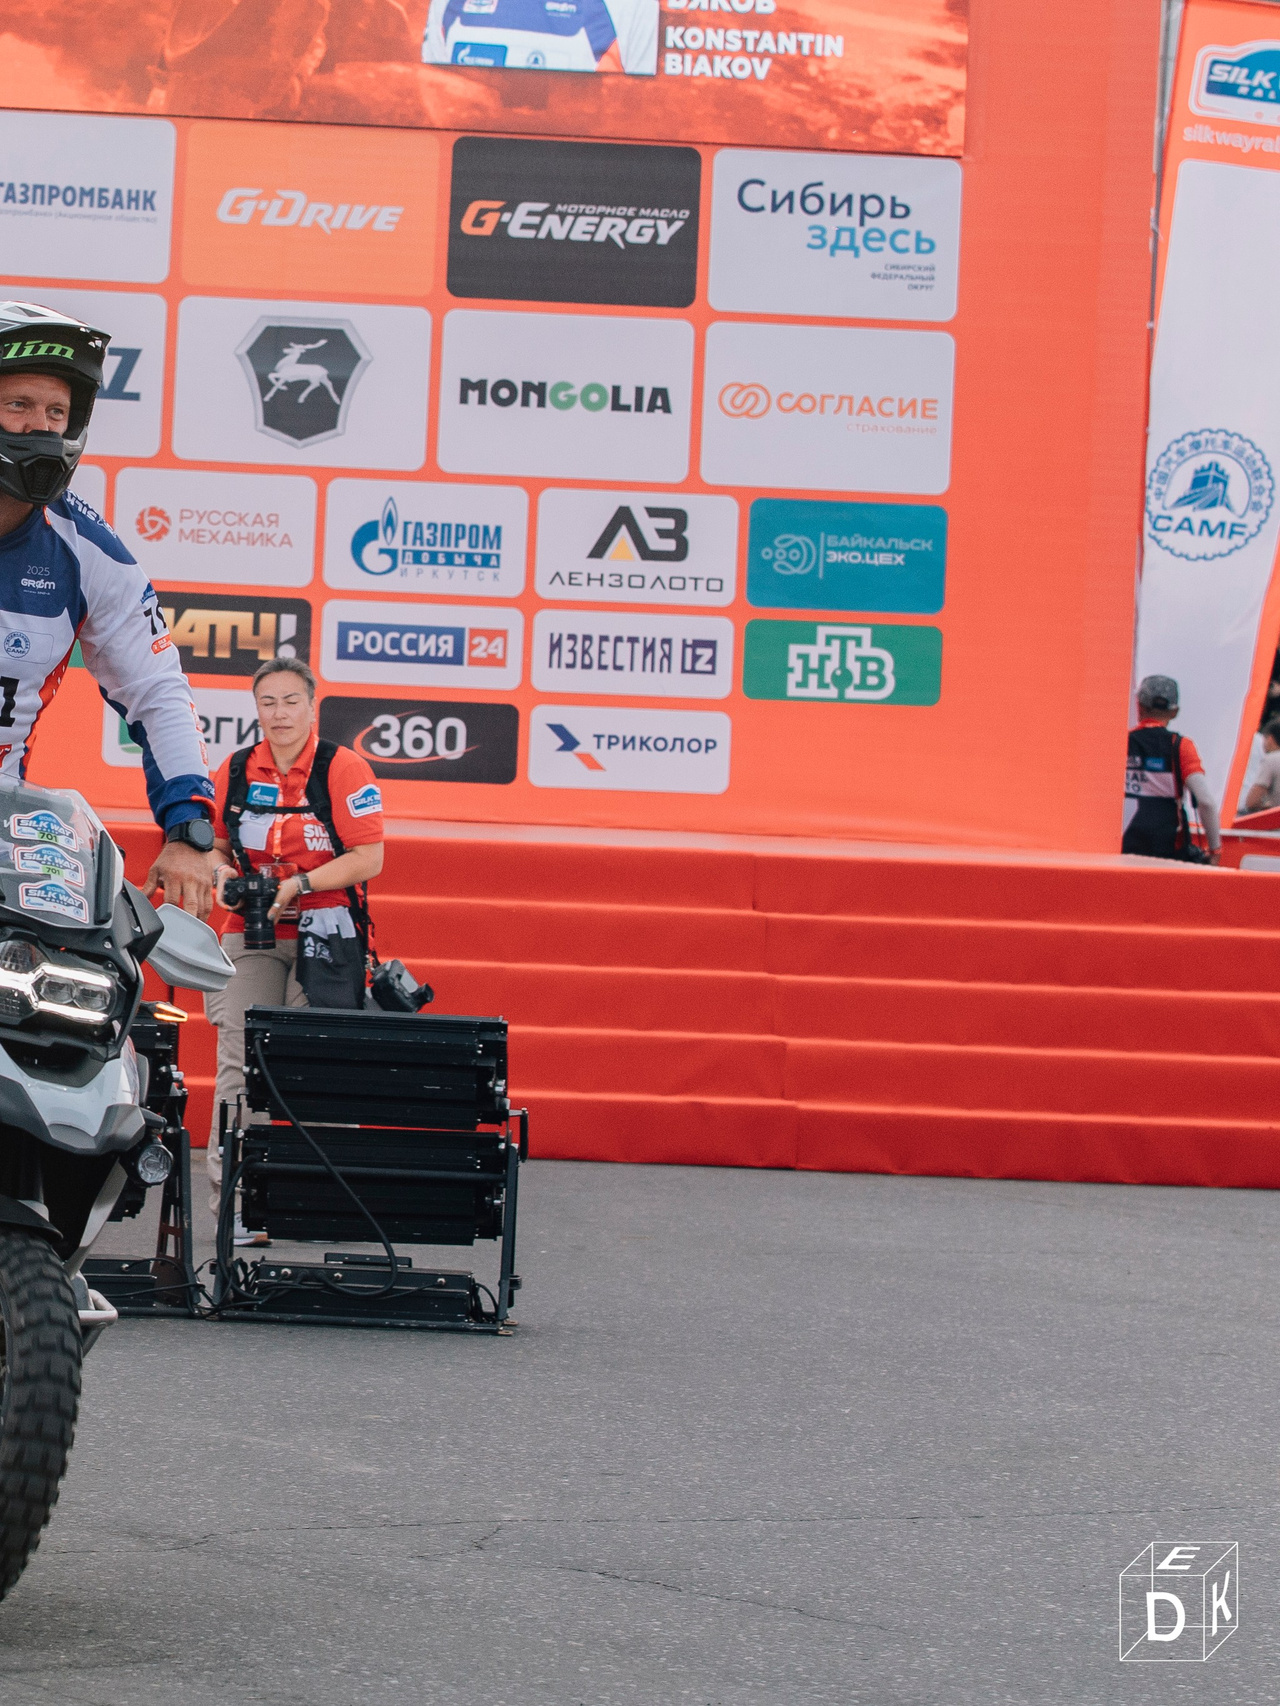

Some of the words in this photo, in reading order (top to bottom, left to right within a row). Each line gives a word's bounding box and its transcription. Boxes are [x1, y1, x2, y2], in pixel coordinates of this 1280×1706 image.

[665, 26, 844, 57] KONSTANTIN
[664, 53, 772, 80] BIAKOV
[1209, 63, 1277, 89] SILK
[556, 203, 636, 217] МОТОРНОЕ
[639, 206, 691, 219] МАСЛО
[737, 178, 911, 227] Сибирь
[806, 225, 936, 259] здесь
[95, 346, 143, 401] Z
[459, 377, 673, 415] MONGOLIA
[776, 391, 939, 420] СОГЛАСИЕ
[846, 422, 938, 434] страхование
[179, 508, 280, 528] РУССКАЯ
[1152, 514, 1248, 540] CAMF
[178, 528, 293, 548] МЕХАНИКА
[402, 521, 502, 550] ГАЗПРОМ
[826, 533, 933, 551] БАЙКАЛЬСК
[403, 551, 499, 567] ДОБЫЧА
[825, 550, 905, 567] ЭКО.ЦЕХ
[27, 565, 50, 576] 2025
[400, 567, 500, 582] ИРКУТСК
[549, 571, 724, 592] ЛЕНЗОЛОТО
[347, 630, 454, 658] РОССИЯ
[470, 636, 504, 660] 24
[549, 633, 672, 674] ИЗВЕСТИЯ
[789, 626, 893, 698] НТВ
[370, 714, 467, 760] 360
[593, 734, 718, 754] ТРИКОЛОР
[19, 819, 50, 828] SILK
[50, 822, 72, 836] WAY
[40, 832, 57, 842] 701
[23, 853, 53, 863] SILK
[54, 857, 77, 870] WAY
[46, 867, 60, 876] 701
[27, 889, 58, 899] SILK
[58, 893, 81, 906] WAY
